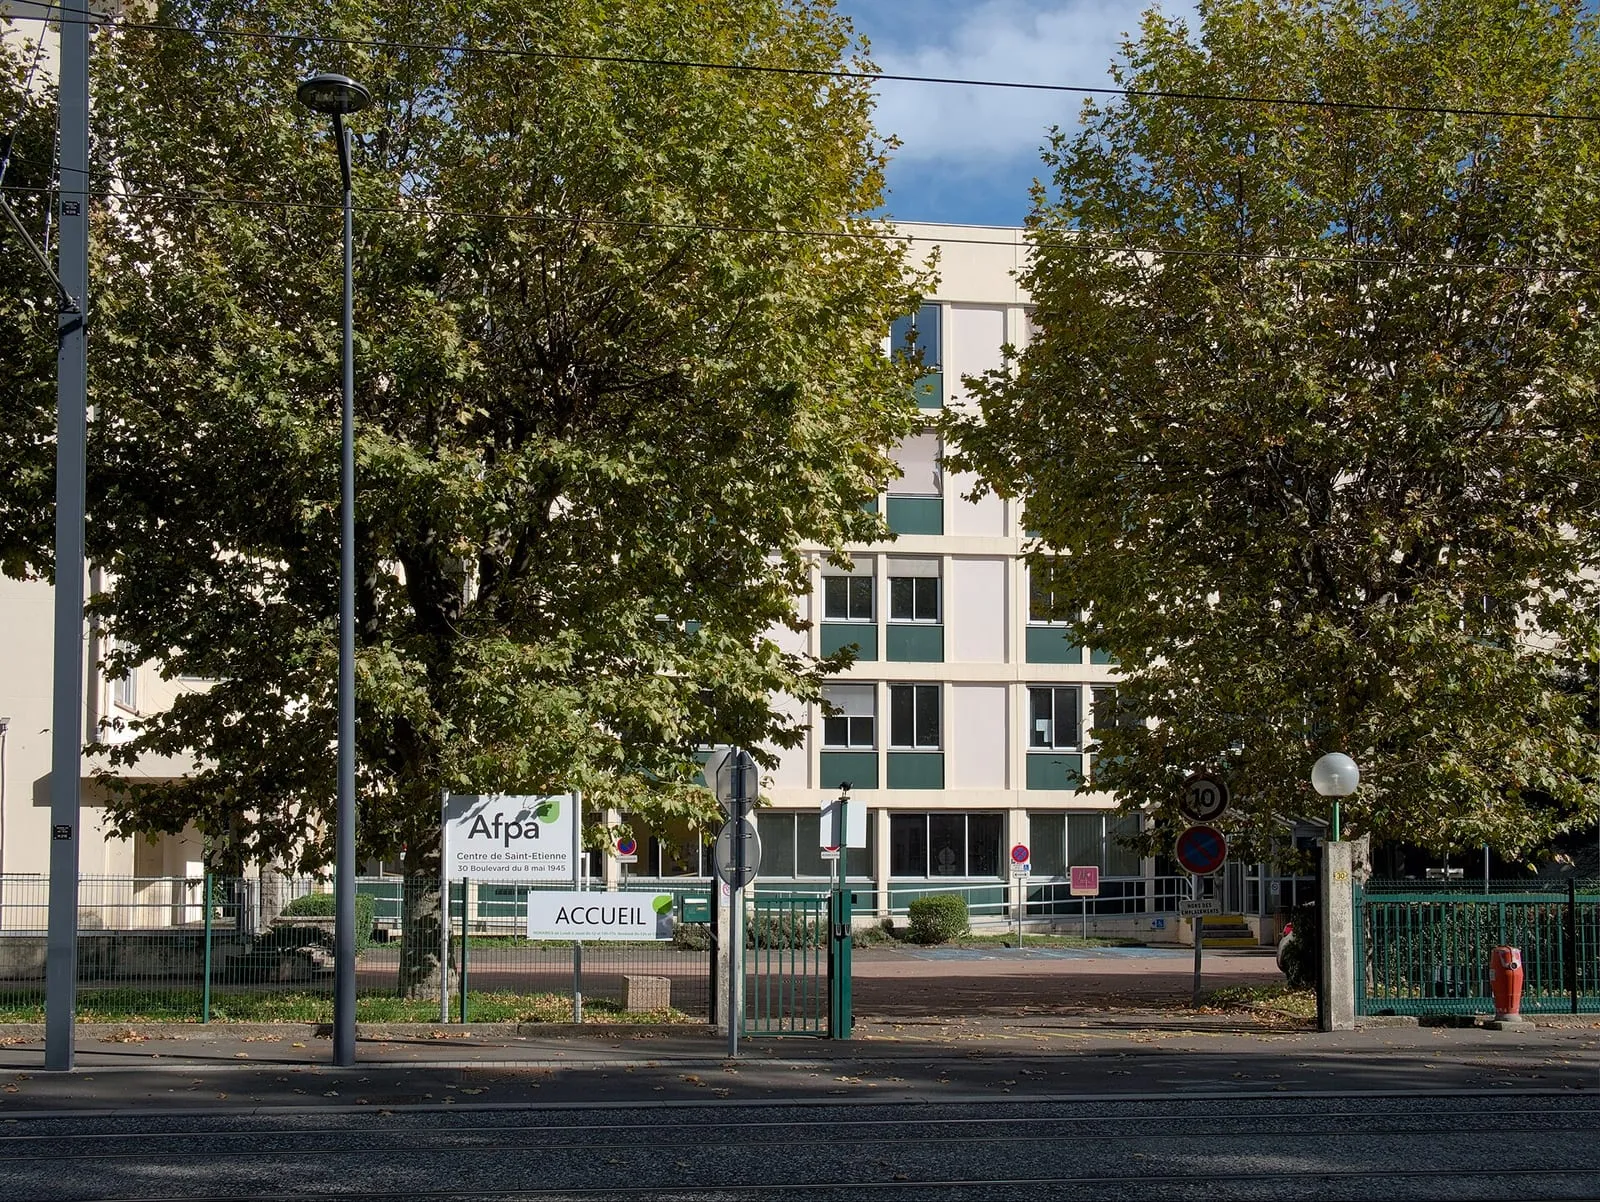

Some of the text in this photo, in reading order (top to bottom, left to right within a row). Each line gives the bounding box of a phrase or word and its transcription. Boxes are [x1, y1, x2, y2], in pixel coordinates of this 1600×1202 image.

[1192, 788, 1214, 808] 10
[468, 812, 540, 848] Afpa
[456, 852, 566, 860] Centre de Saint-Etienne
[555, 906, 646, 925] ACCUEIL
